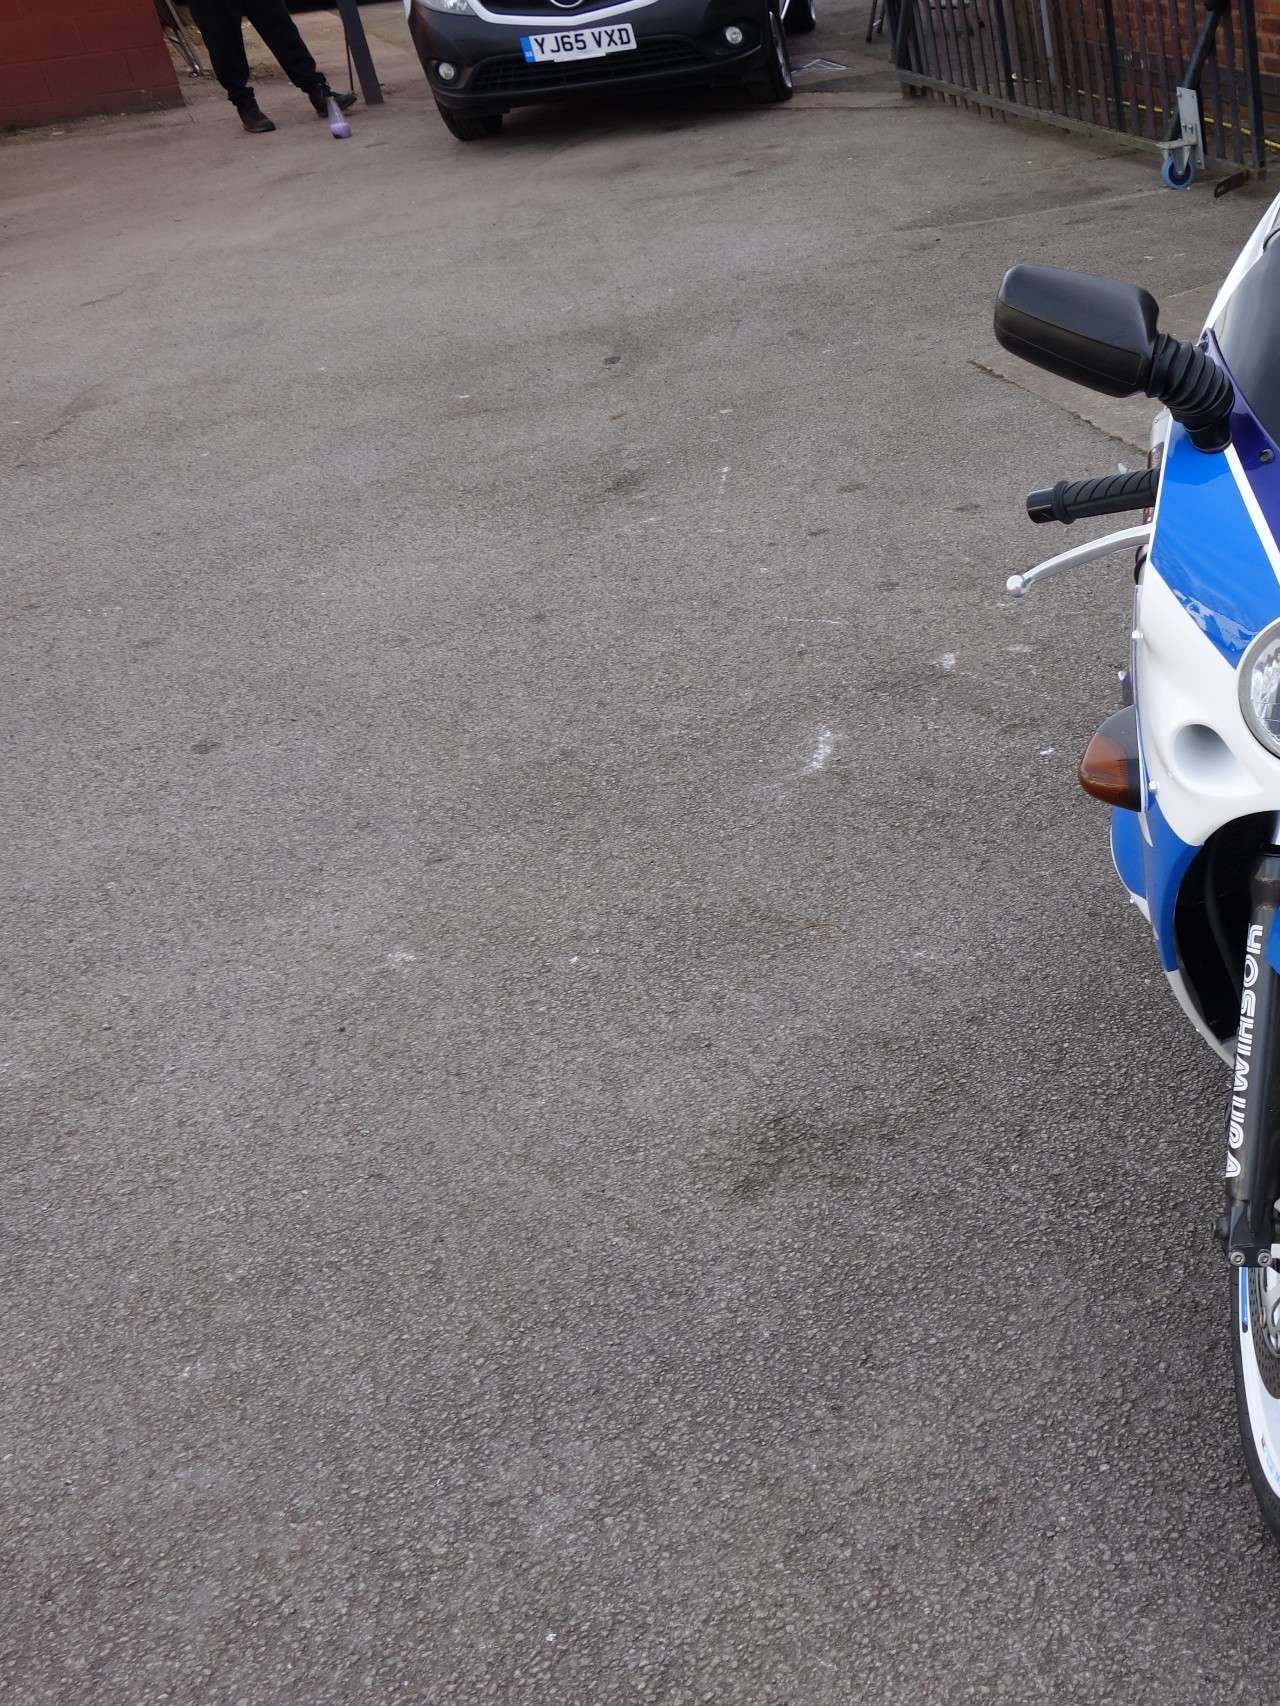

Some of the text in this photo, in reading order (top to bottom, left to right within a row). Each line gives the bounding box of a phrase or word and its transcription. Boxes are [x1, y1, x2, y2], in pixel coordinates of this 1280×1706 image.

[534, 28, 631, 54] YJ65 VXD
[1225, 922, 1264, 1178] YOSHIMURA
